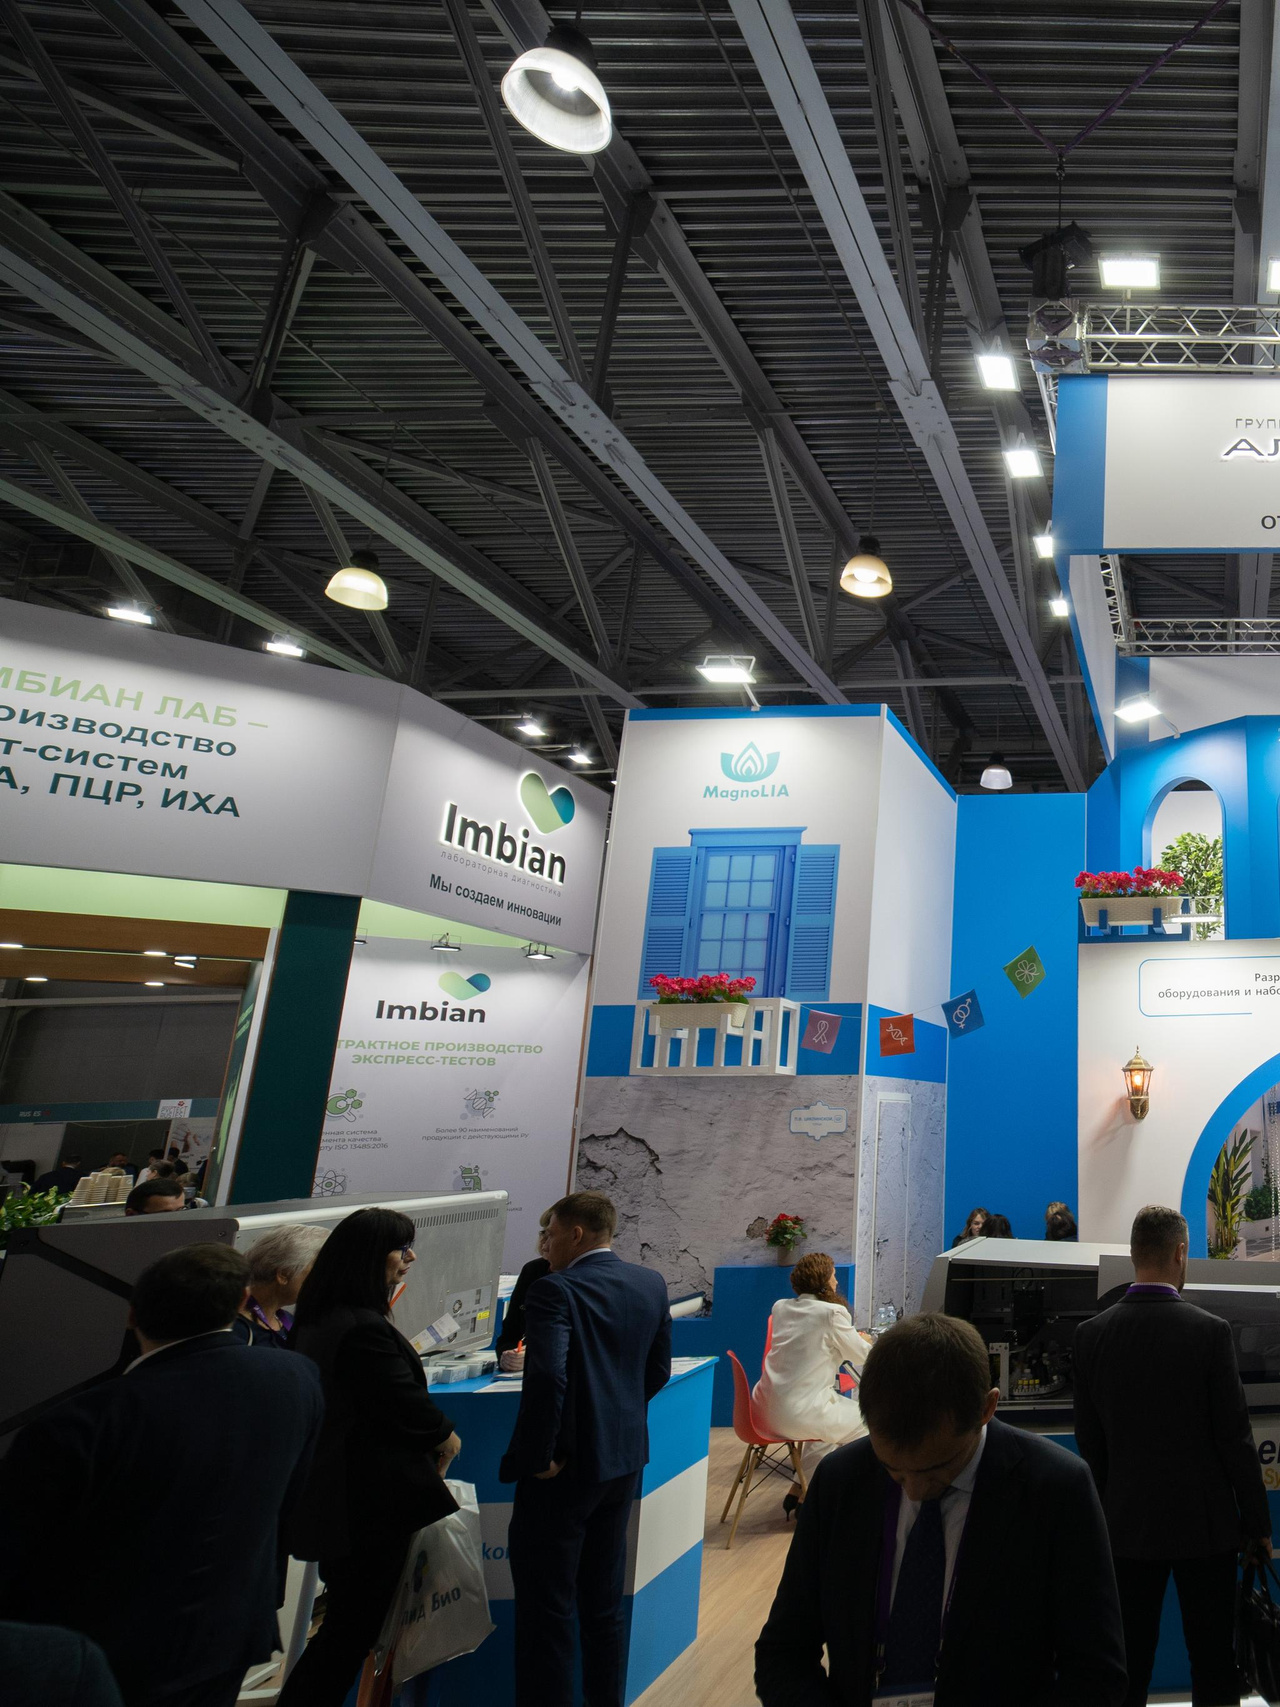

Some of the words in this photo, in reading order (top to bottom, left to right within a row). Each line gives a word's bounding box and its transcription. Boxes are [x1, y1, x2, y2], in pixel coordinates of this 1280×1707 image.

[154, 696, 238, 727] ЛАБ
[49, 773, 145, 809] ПЦР,
[161, 788, 240, 818] ИХА
[703, 784, 789, 802] MagnoLIA
[443, 801, 568, 886] Imbian
[441, 851, 509, 879] лабораторная
[511, 874, 562, 898] диагностика
[430, 873, 452, 894] Мы
[455, 885, 504, 910] создаем
[507, 901, 562, 927] инновации
[1158, 989, 1240, 1000] оборудования
[1244, 988, 1251, 996] и
[376, 1000, 486, 1023] Imbian
[351, 1054, 496, 1067] ЭКСПРЕСС-ТЕСТОВ
[425, 1041, 543, 1054] ПРОИЗВОДСТВО
